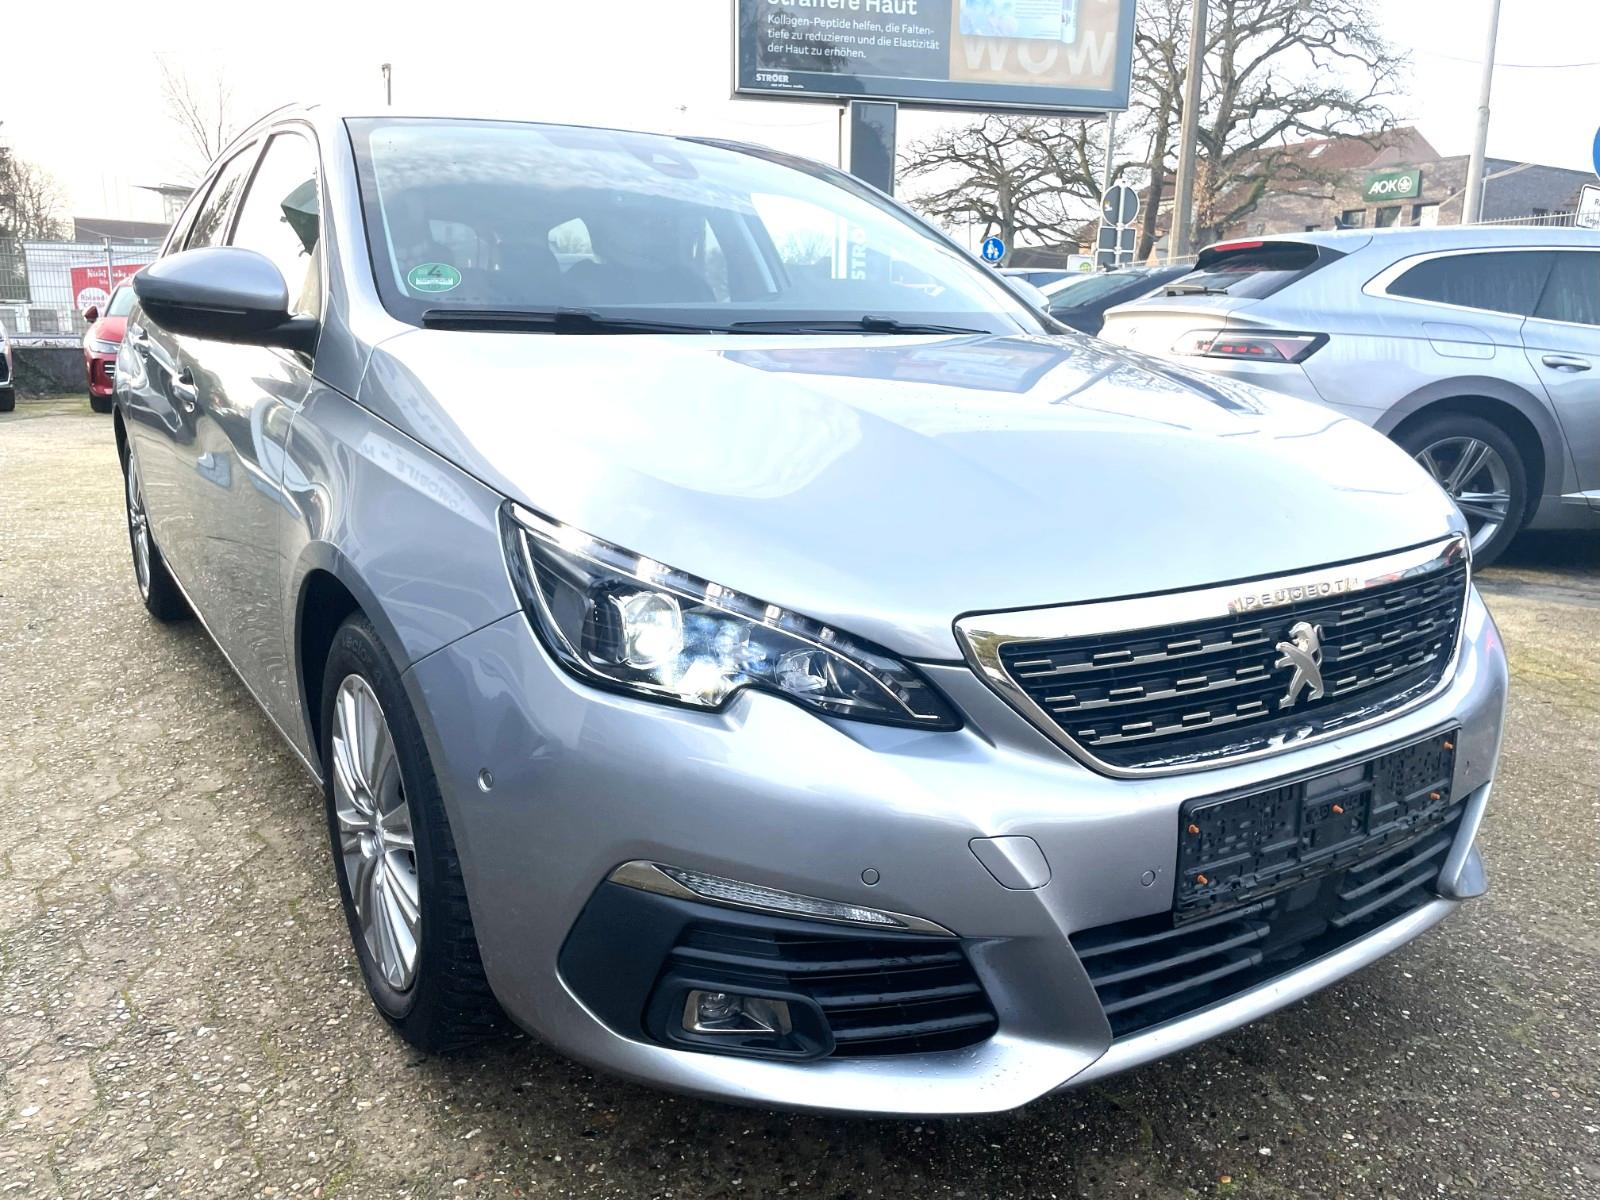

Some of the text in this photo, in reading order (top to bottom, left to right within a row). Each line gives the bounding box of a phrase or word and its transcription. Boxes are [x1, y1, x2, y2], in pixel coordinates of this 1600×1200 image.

[866, 0, 917, 15] Haut
[767, 14, 934, 35] Kollagen-Peptide helfen, die Falten-
[767, 28, 939, 50] tiefe zu reduzieren und die Elastizität
[767, 42, 866, 58] der Haut zu erhöhen.
[963, 30, 1115, 76] WOW
[1368, 179, 1397, 195] AOK
[427, 265, 443, 277] 4
[1245, 578, 1345, 607] PEUGEOT
